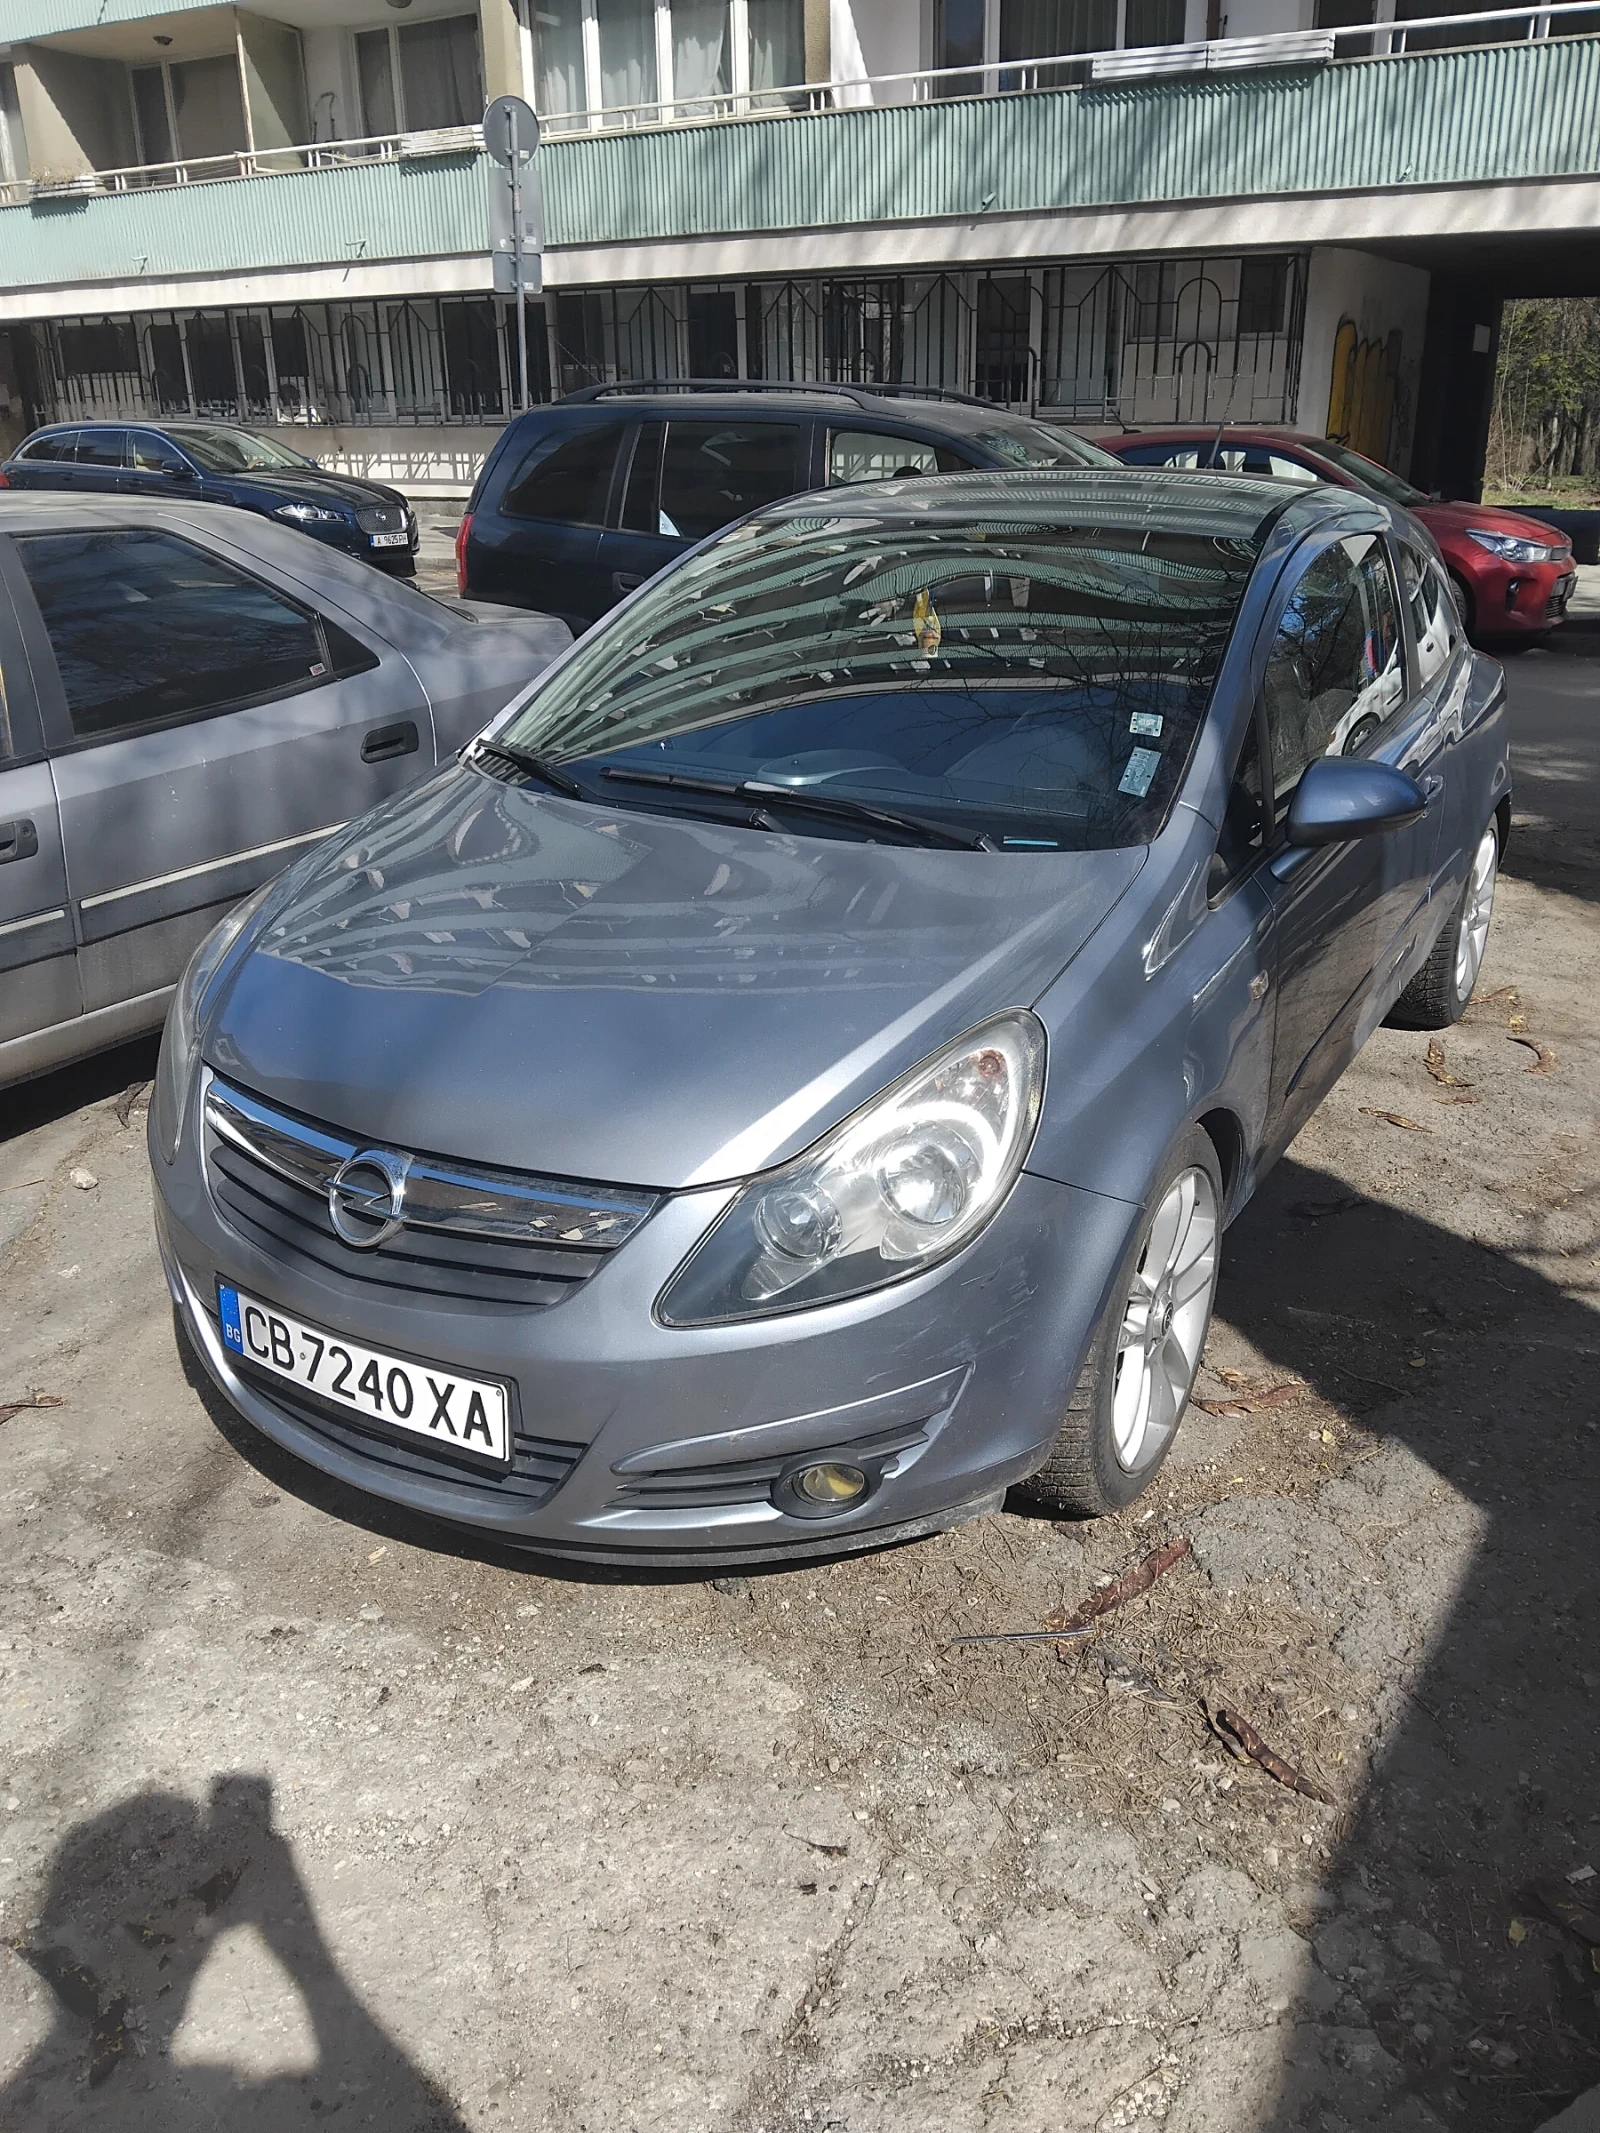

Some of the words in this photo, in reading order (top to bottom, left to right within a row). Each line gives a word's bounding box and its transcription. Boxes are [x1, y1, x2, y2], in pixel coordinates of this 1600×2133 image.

[225, 1323, 241, 1343] BG
[245, 1305, 295, 1371] CB
[301, 1331, 414, 1420] 7240
[425, 1376, 493, 1448] XA
